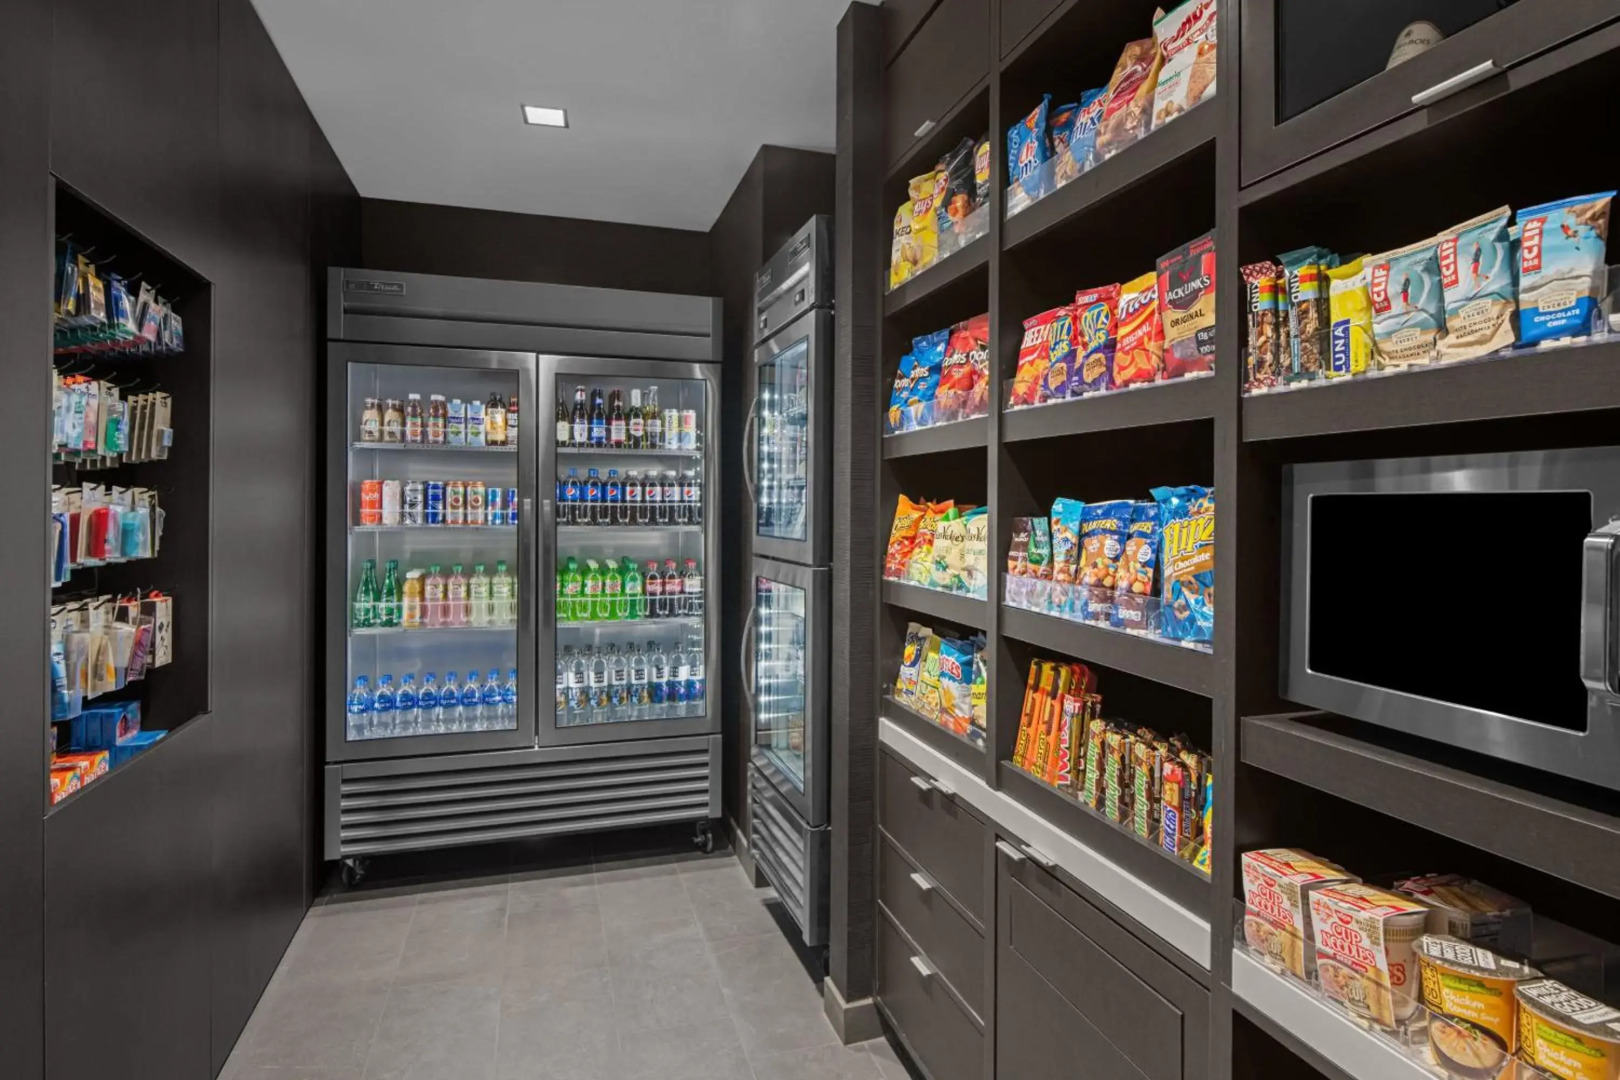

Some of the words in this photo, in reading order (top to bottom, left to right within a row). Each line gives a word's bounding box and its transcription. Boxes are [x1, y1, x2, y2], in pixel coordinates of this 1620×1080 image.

[1523, 220, 1540, 259] CLIF
[1441, 240, 1455, 275] CLIF
[1251, 281, 1260, 312] KIND
[1290, 269, 1300, 303] KIND
[1372, 267, 1388, 302] CLIF
[1170, 308, 1205, 329] ORIGINAL
[1533, 308, 1580, 322] CHOCOLATE
[1547, 319, 1567, 327] CHIP
[1334, 325, 1347, 374] LUNA
[1163, 804, 1177, 855] ICKERS
[1248, 889, 1295, 927] NOODLES
[1257, 883, 1283, 905] CUP
[1320, 929, 1377, 968] NOODLES
[1330, 922, 1362, 945] CUP
[1442, 987, 1485, 1009] Chicken
[1446, 1000, 1478, 1018] Ramen
[1536, 1038, 1582, 1069] Chicken
